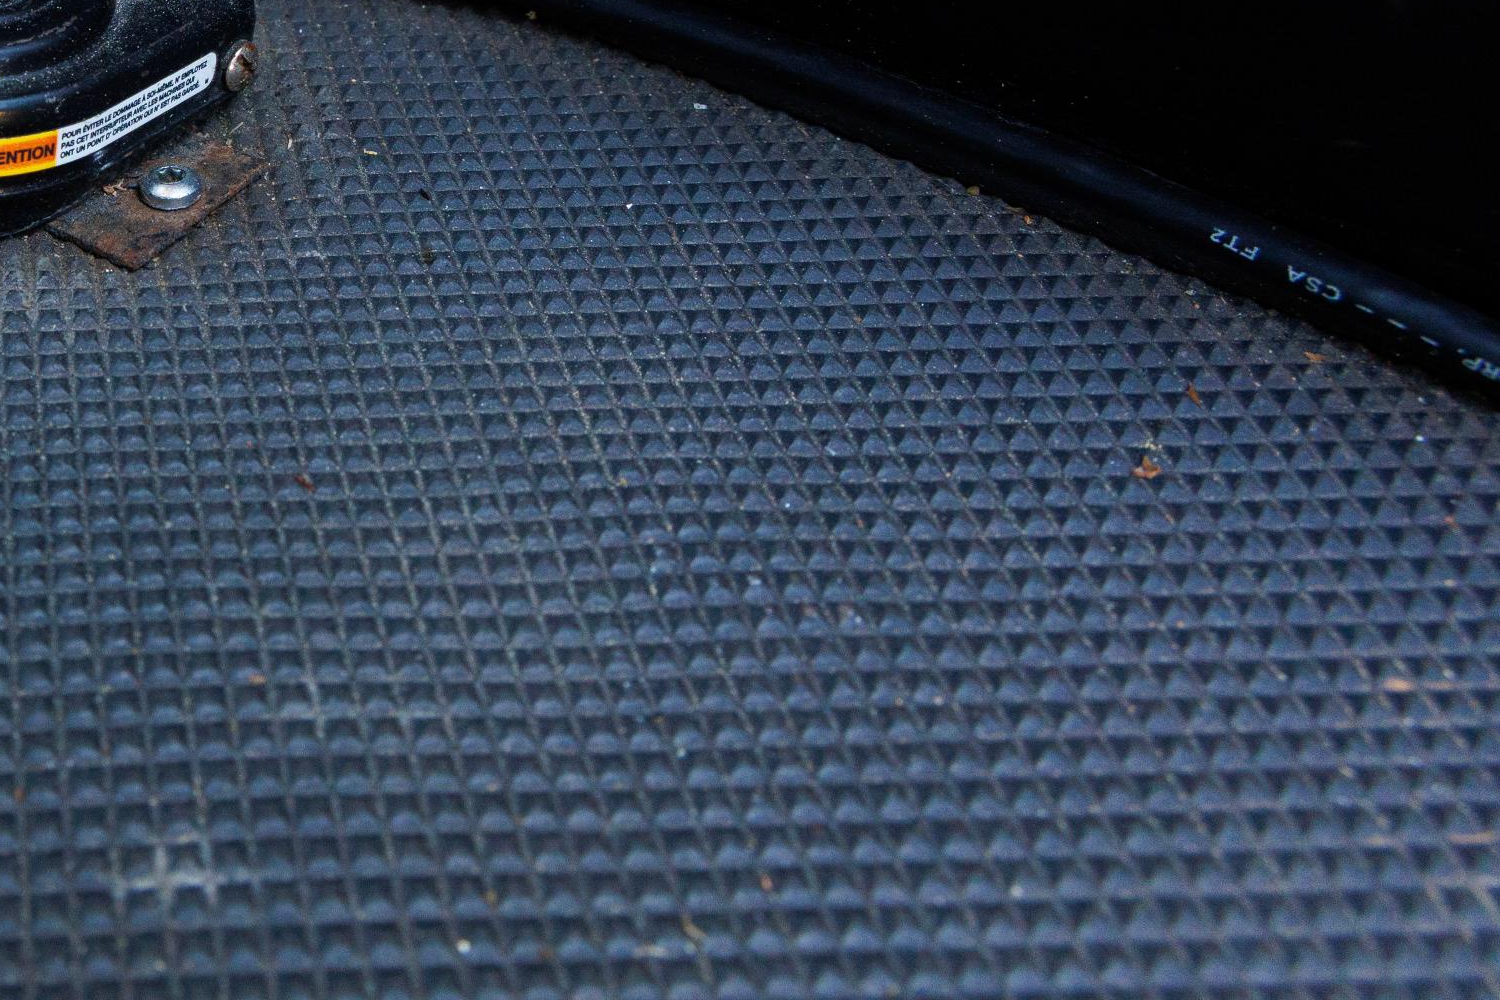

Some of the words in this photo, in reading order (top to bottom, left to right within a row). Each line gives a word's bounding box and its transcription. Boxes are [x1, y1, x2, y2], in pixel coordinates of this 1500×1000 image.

[60, 148, 75, 159] ONT
[76, 144, 86, 154] UN
[86, 135, 105, 150] POINT
[112, 114, 144, 136] OPÉRATION
[143, 109, 154, 118] QUI
[160, 98, 171, 110] EST
[171, 92, 182, 104] PAS
[61, 128, 82, 140] POUR
[83, 118, 105, 134] ÉVITER
[105, 113, 112, 122] LE
[112, 97, 142, 118] DOMMAGE
[181, 60, 208, 81] EMPLOYEZ
[61, 139, 75, 150] PAS
[76, 134, 89, 145] CET
[90, 111, 133, 139] INTERRUPTEUR
[133, 103, 148, 116] AVEC
[148, 97, 158, 106] LES
[158, 81, 186, 100] MACHINES
[186, 76, 196, 85] QUI
[1209, 227, 1261, 261] FT2
[1287, 265, 1341, 300] CSA
